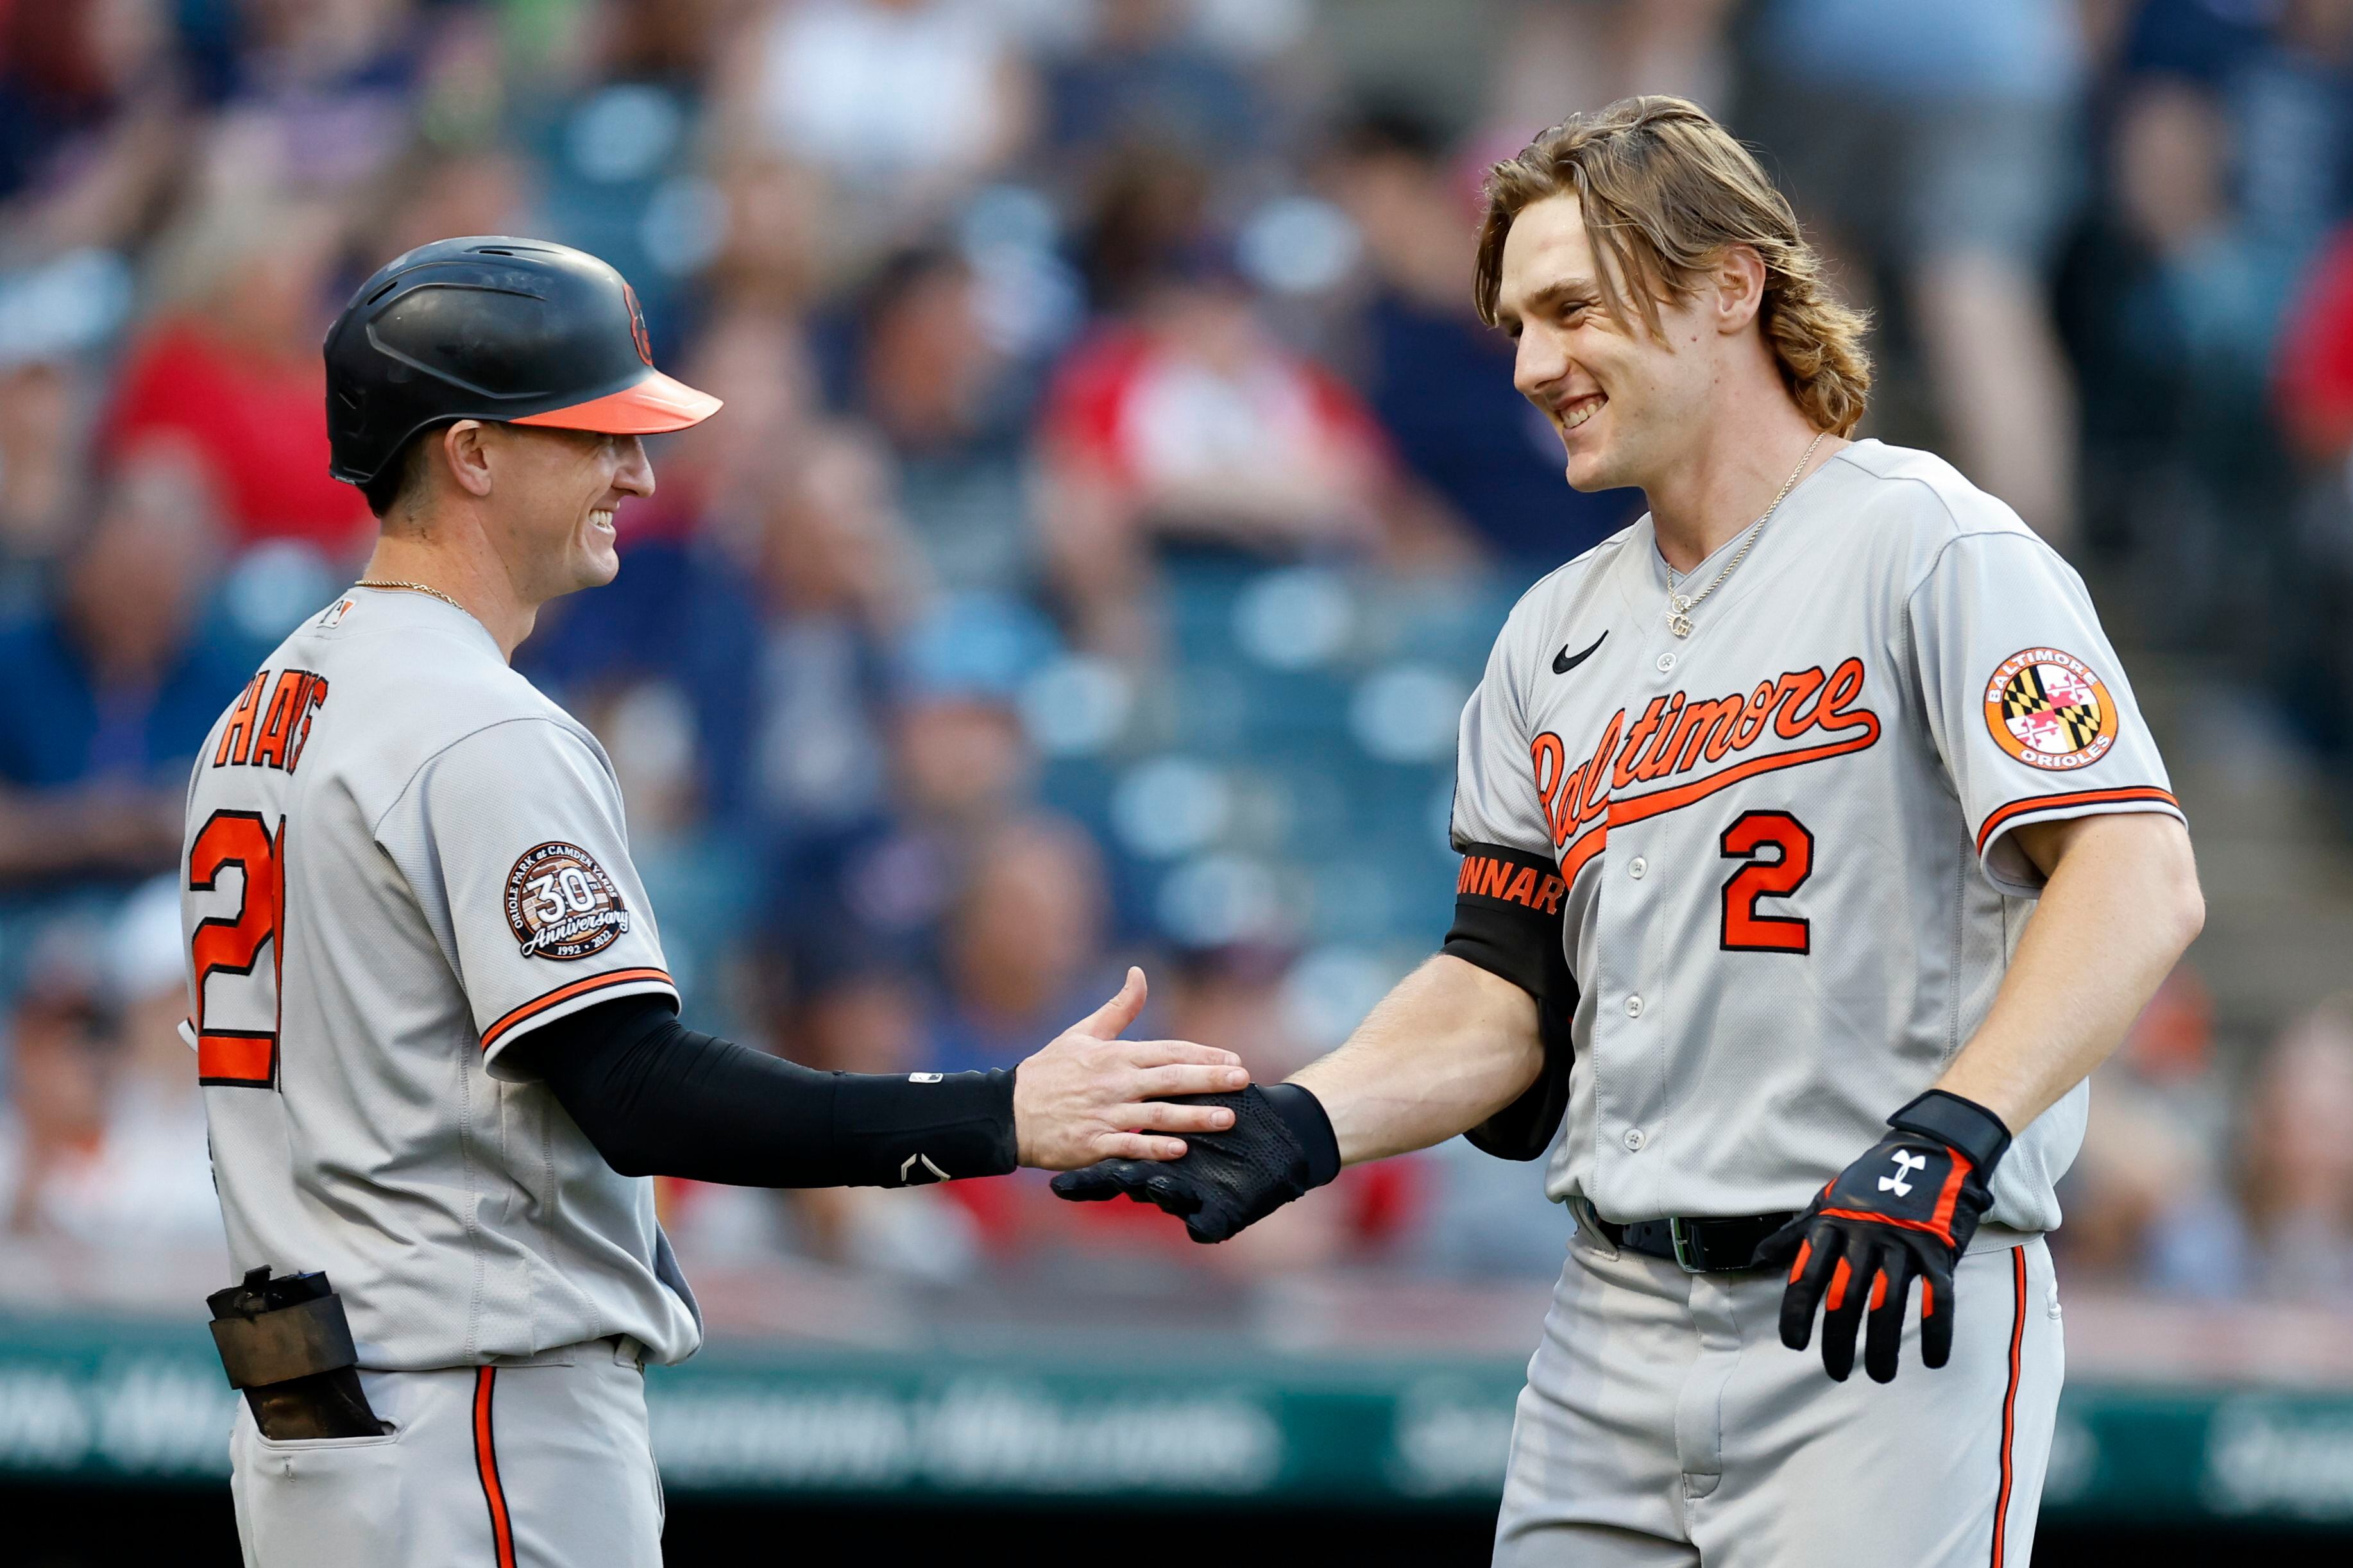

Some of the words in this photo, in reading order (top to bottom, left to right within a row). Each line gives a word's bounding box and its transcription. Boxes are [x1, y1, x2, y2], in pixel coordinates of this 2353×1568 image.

[1987, 650, 2098, 703] BALTIMORE
[1531, 657, 1881, 849] Baltimore
[2020, 734, 2111, 768] ORIOLES
[512, 856, 536, 884] PARK
[536, 850, 548, 860] at
[547, 845, 593, 867] CAMDEN
[525, 867, 597, 923] 30
[592, 865, 618, 898] YARDS
[1720, 809, 1814, 956] 2
[509, 884, 523, 929] ORIOLE
[521, 910, 629, 956] Anniversary
[557, 945, 581, 956] 1992
[591, 930, 613, 948] 2022
